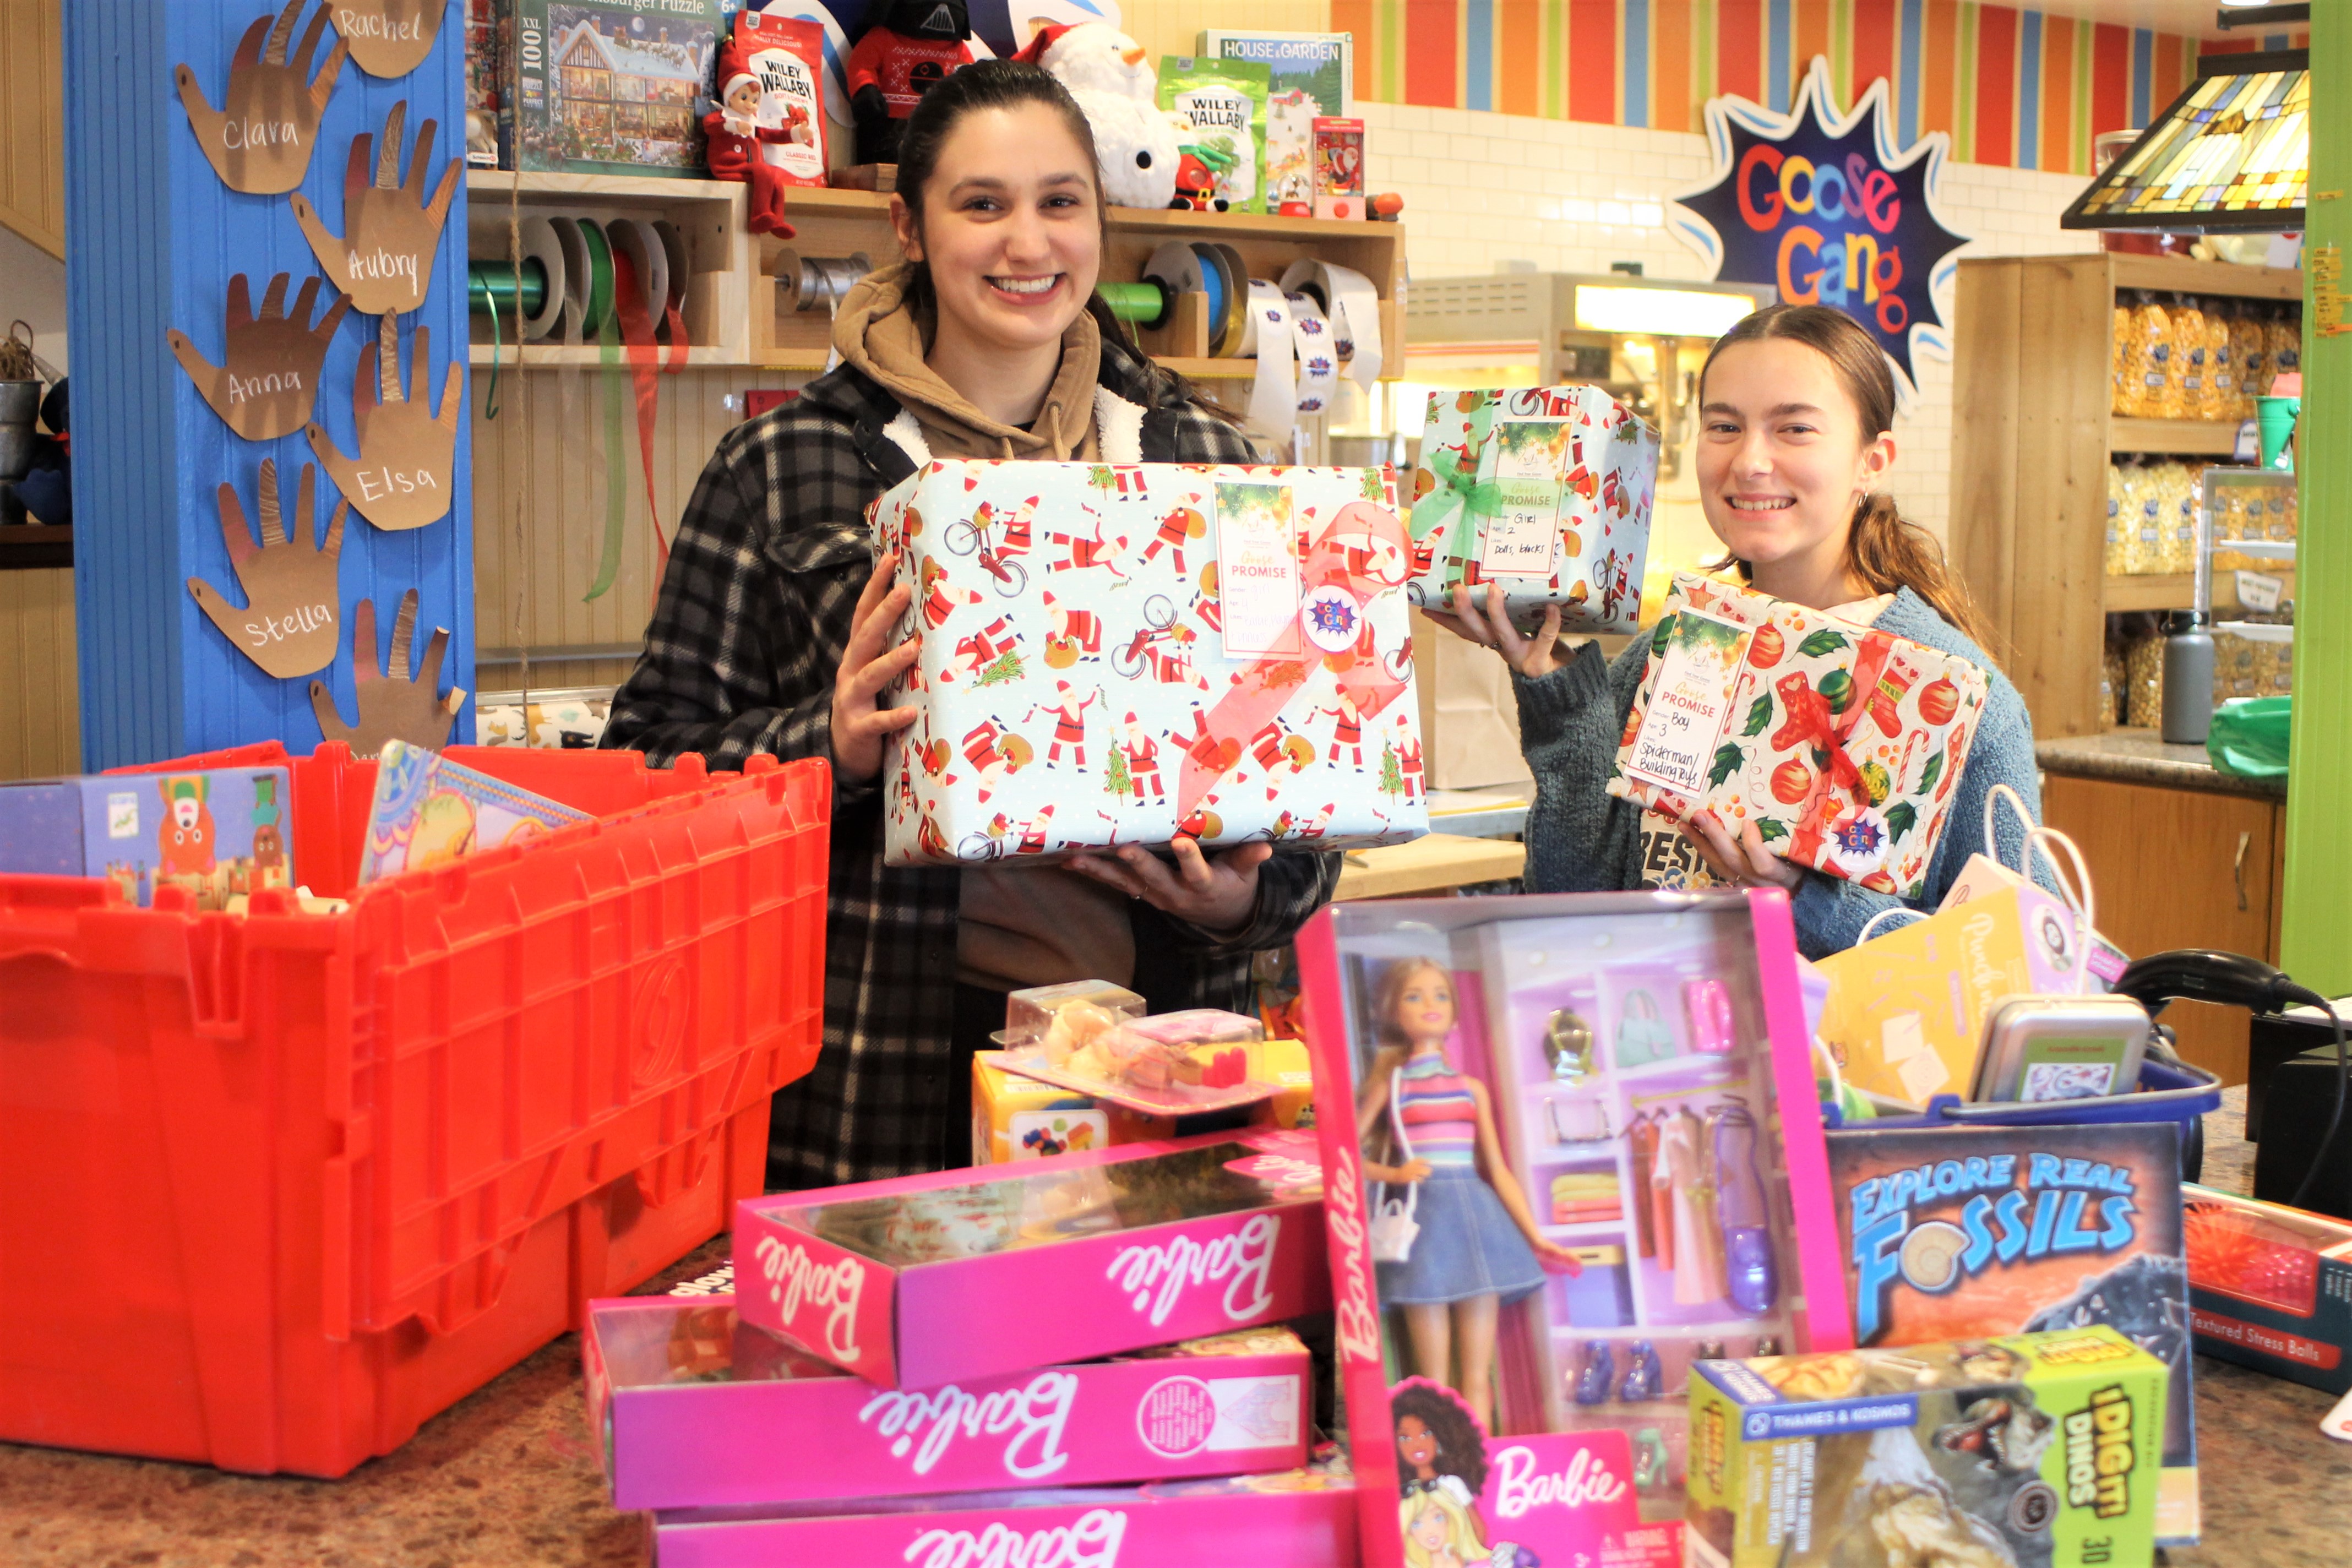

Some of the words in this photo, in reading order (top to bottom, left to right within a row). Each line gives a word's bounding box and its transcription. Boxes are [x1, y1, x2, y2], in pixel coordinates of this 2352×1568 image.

[523, 17, 541, 29] XXL
[662, 0, 705, 14] Puzzle
[339, 9, 420, 42] Rachel
[522, 30, 542, 70] 100
[772, 39, 802, 48] DELICIOUS!
[1225, 41, 1275, 58] HOUSE
[1281, 43, 1339, 60] GARDEN
[765, 60, 801, 79] WILEY
[760, 73, 813, 101] WALLABY
[1185, 111, 1245, 132] WALLABY
[1192, 99, 1242, 111] WILEY
[224, 117, 299, 150] Clara
[786, 151, 808, 159] CLASSIC
[1736, 144, 1902, 234] Goose
[348, 247, 418, 296] Aubry
[1777, 225, 1908, 335] Gang
[229, 371, 302, 404] Anna
[356, 466, 437, 502] Elsa
[1501, 496, 1550, 506] PROMISE
[1232, 565, 1287, 578] PROMISE
[245, 604, 333, 647] Stella
[1662, 691, 1716, 718] PROMISE
[1671, 711, 1690, 731] Boy
[1659, 723, 1667, 737] 3
[1640, 756, 1678, 783] Building
[1678, 767, 1698, 790] Toys
[1850, 1154, 2017, 1235] EXPLORE
[2028, 1152, 2135, 1195] REAL
[1107, 1214, 1281, 1327] Barbie
[1329, 1147, 1379, 1363] Barbie
[754, 1236, 864, 1363] Barbie
[2190, 1311, 2243, 1341] Textured
[2247, 1327, 2284, 1352] Stress
[2288, 1339, 2320, 1361] Balls
[859, 1371, 1079, 1478] Barbie
[1850, 1403, 1912, 1422] KOSMOS
[2065, 1411, 2097, 1506] DINOS
[1494, 1445, 1627, 1518] Barbie
